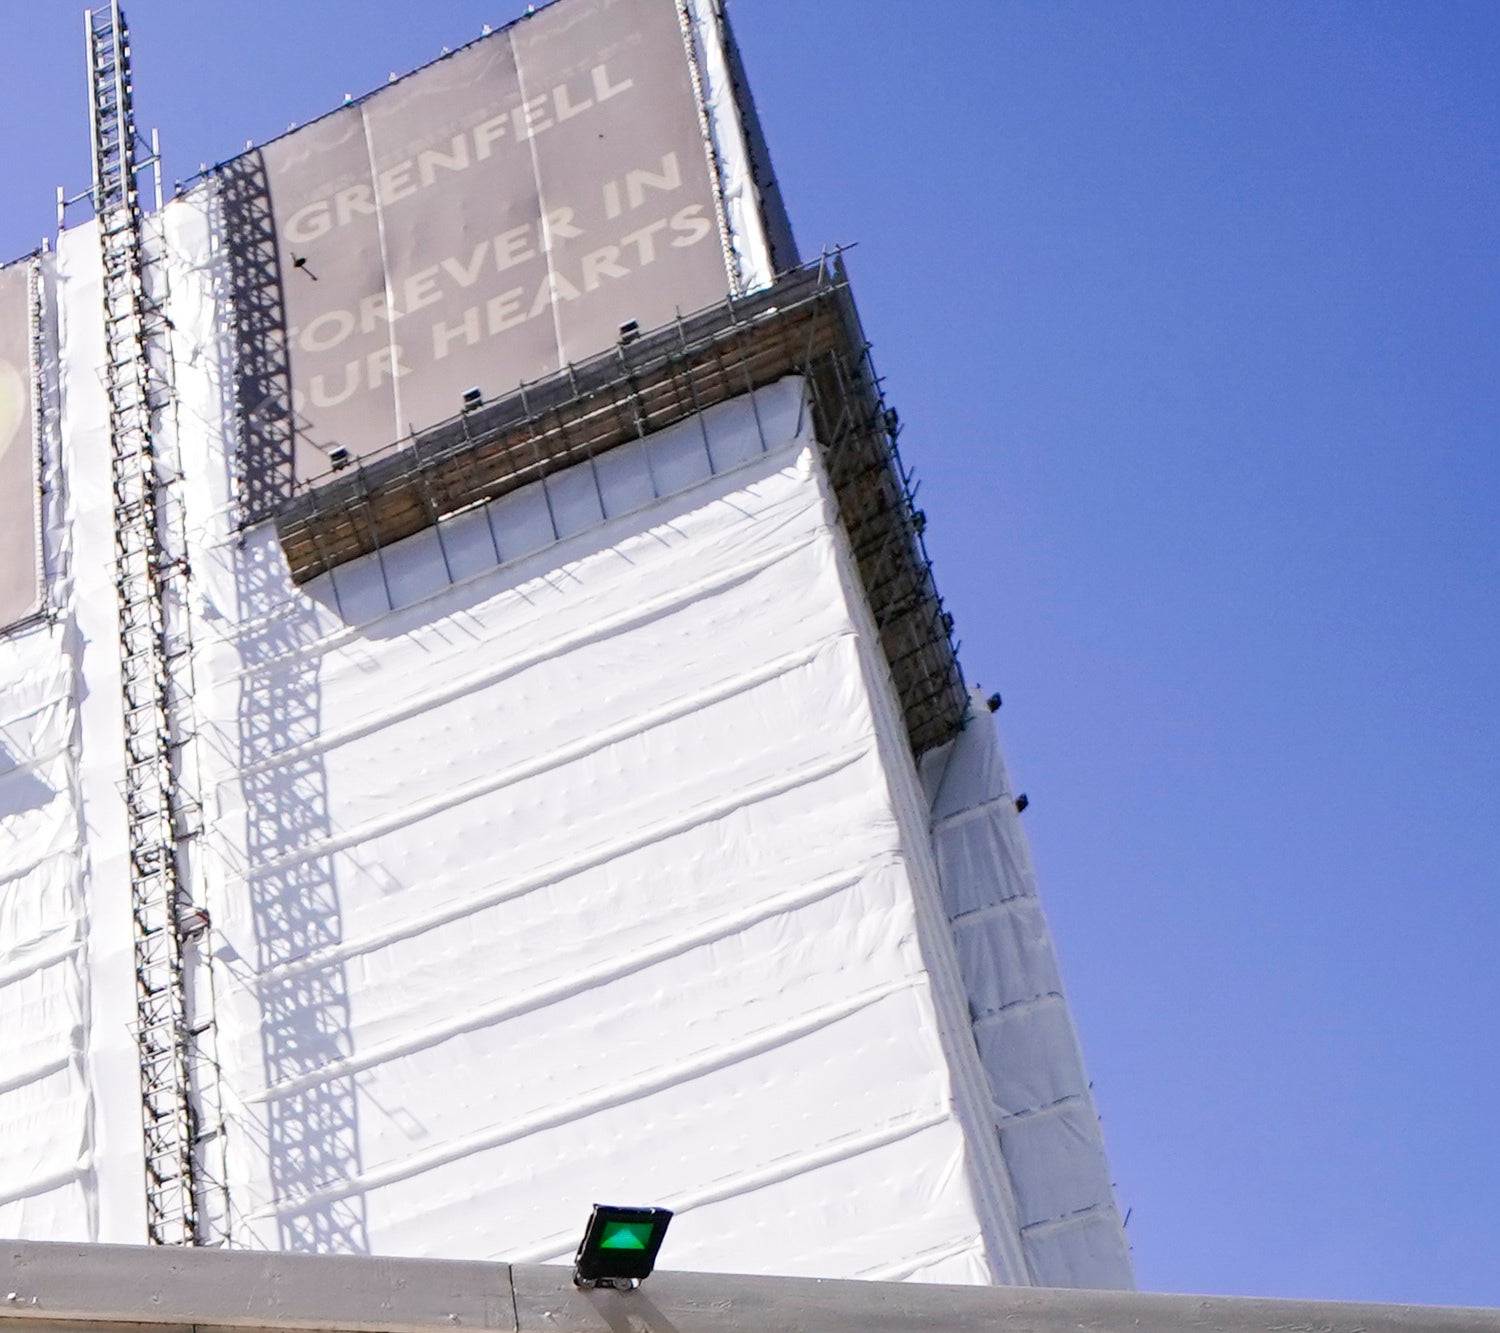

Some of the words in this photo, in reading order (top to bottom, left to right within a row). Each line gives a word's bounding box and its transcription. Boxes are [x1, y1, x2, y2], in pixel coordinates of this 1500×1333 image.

[283, 63, 635, 246] GRENFELL
[605, 152, 684, 210] IN
[432, 203, 714, 358] HEARTS
